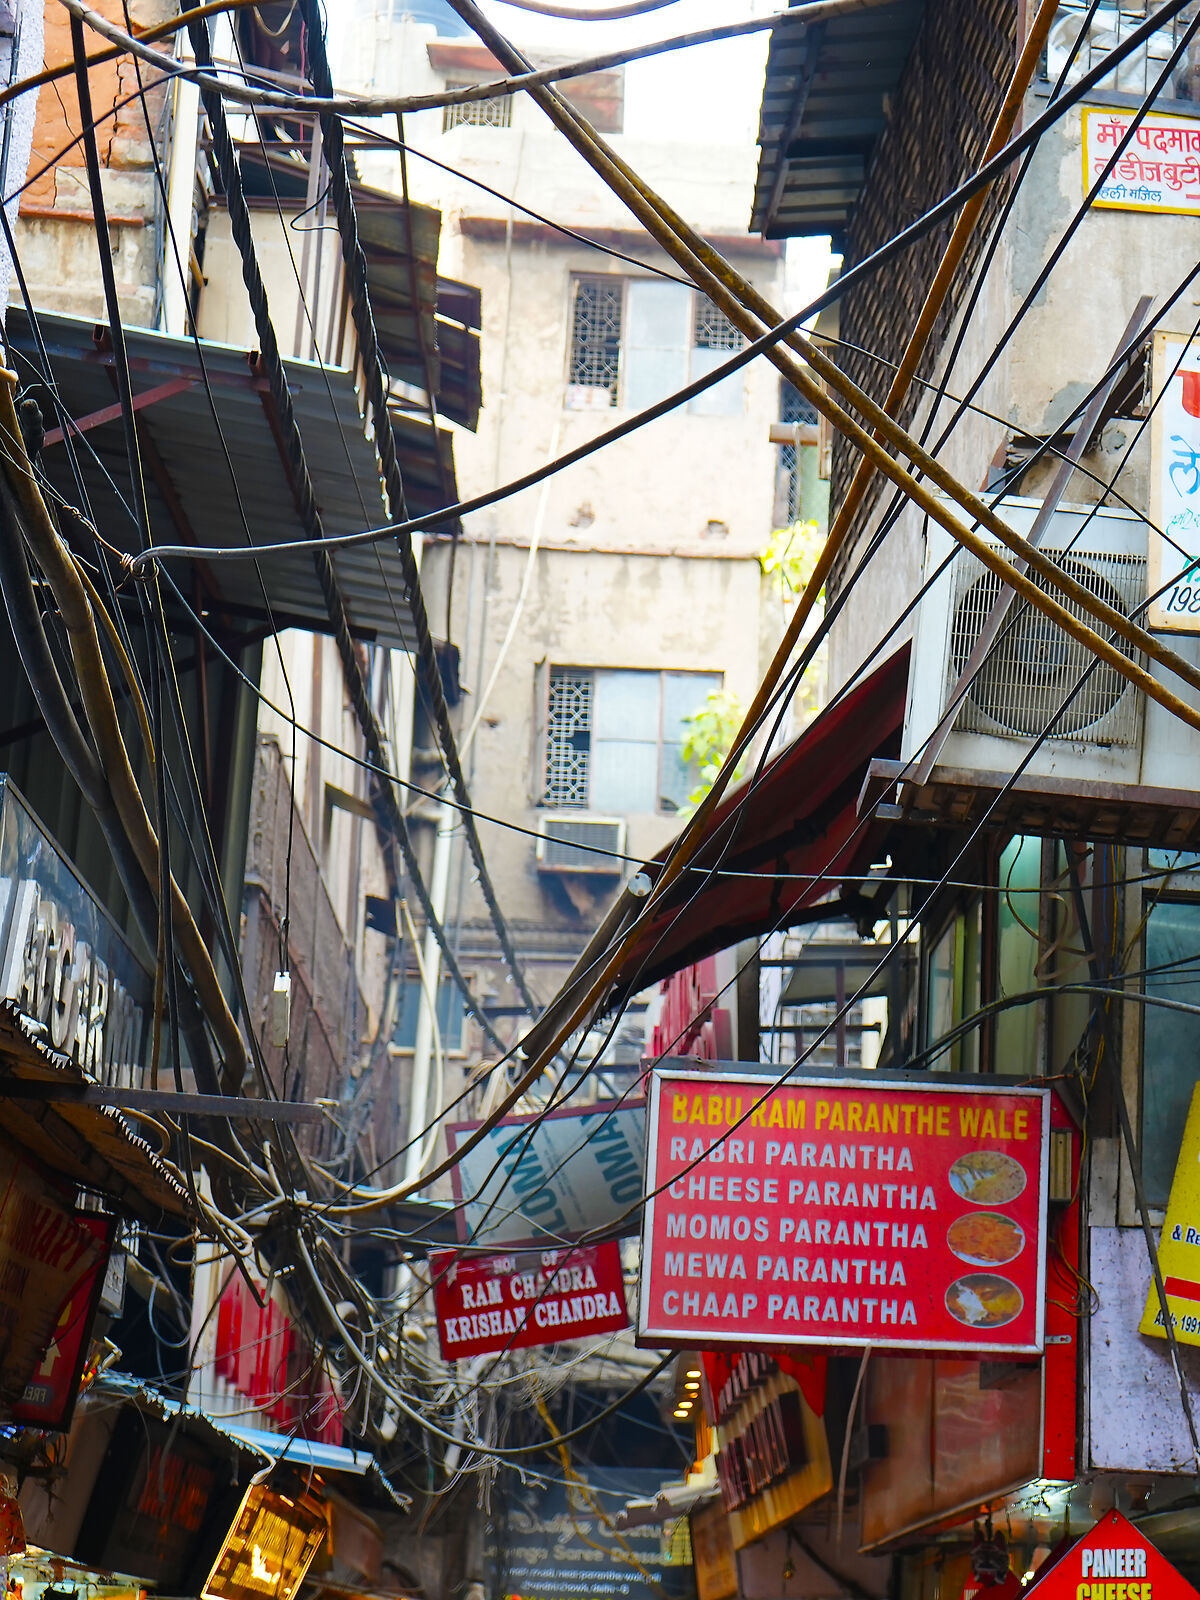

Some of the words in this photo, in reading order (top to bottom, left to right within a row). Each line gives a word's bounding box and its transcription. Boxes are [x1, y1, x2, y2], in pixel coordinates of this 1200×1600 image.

[672, 1093, 742, 1127] BABU
[751, 1097, 806, 1130] RAM
[815, 1100, 950, 1137] PARANTHE
[959, 1107, 1029, 1140] WALE
[670, 1136, 755, 1165] RABRI
[765, 1140, 914, 1172] PARANTHA
[668, 1174, 779, 1204] CHEESE
[788, 1179, 937, 1211] PARANTHA
[666, 1213, 769, 1242] MOMOS
[779, 1217, 929, 1249] PARANTHA
[1171, 1224, 1182, 1241] &
[664, 1251, 747, 1280] MEWA
[757, 1255, 907, 1287] PARANTHA
[460, 1278, 503, 1310] RAM
[510, 1265, 597, 1301] CHANDRA
[444, 1306, 527, 1343] KRISHAN
[534, 1291, 622, 1328] CHANDRA
[662, 1289, 758, 1319] CHAAP
[767, 1294, 918, 1326] PARANTHA
[1081, 1548, 1147, 1579] PANEER
